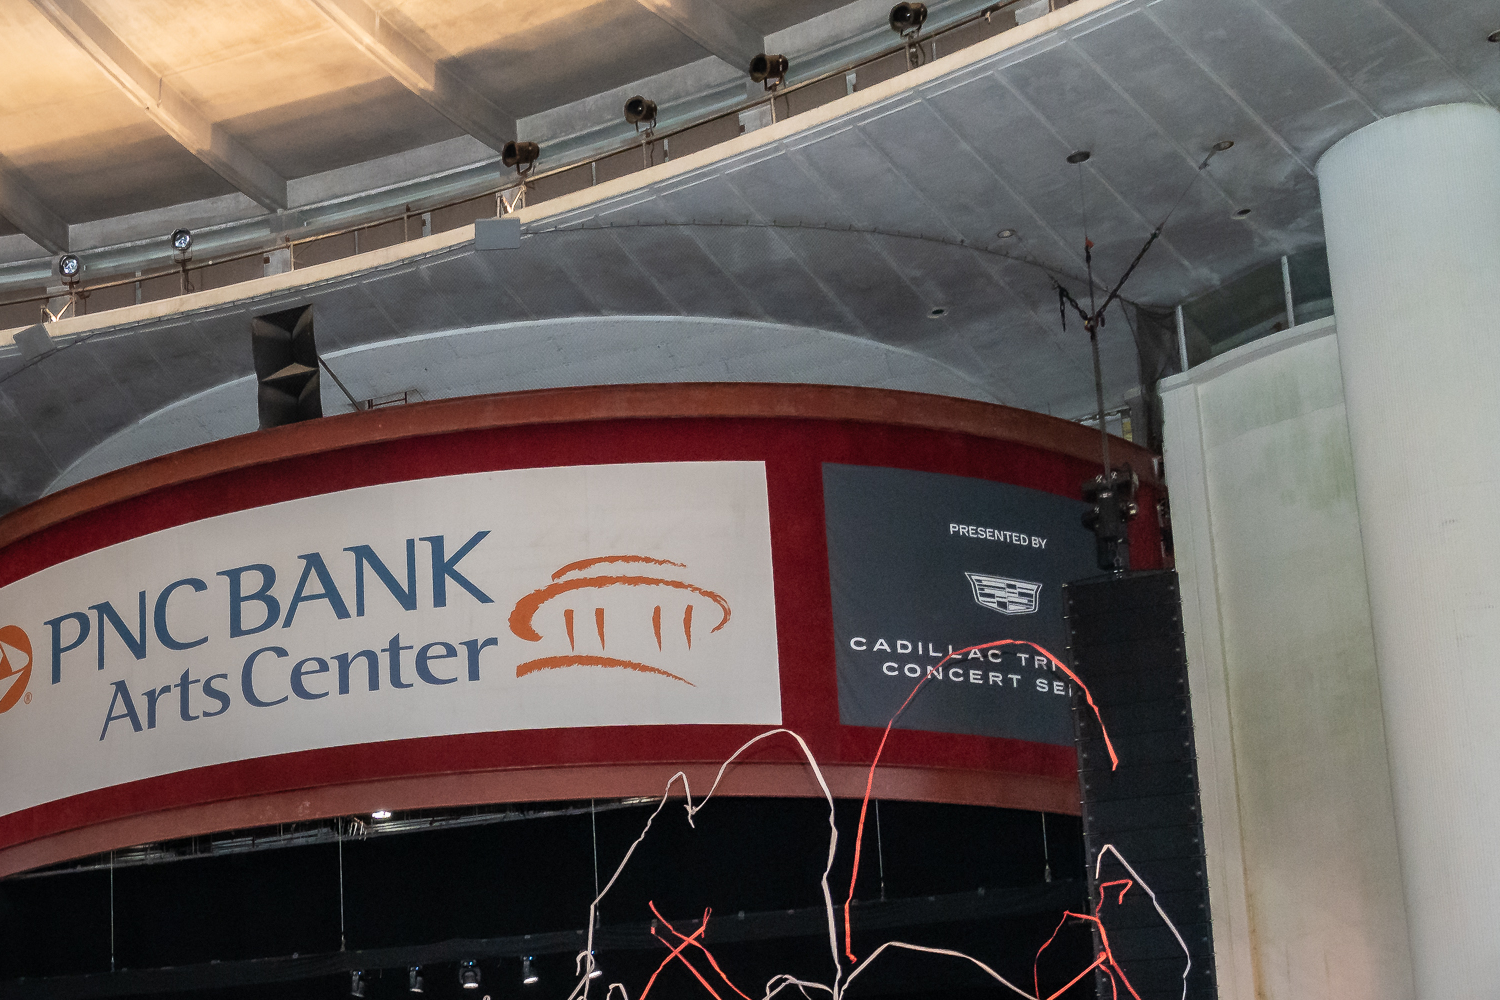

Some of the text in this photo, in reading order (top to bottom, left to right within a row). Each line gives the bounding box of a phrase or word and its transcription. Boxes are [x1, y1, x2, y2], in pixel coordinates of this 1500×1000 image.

[949, 523, 1048, 550] PRESENTED BY
[43, 530, 496, 685] PNC BANK
[849, 636, 1003, 664] CADILLAC
[99, 632, 499, 741] Arts Center
[882, 662, 1022, 688] CONCERT
